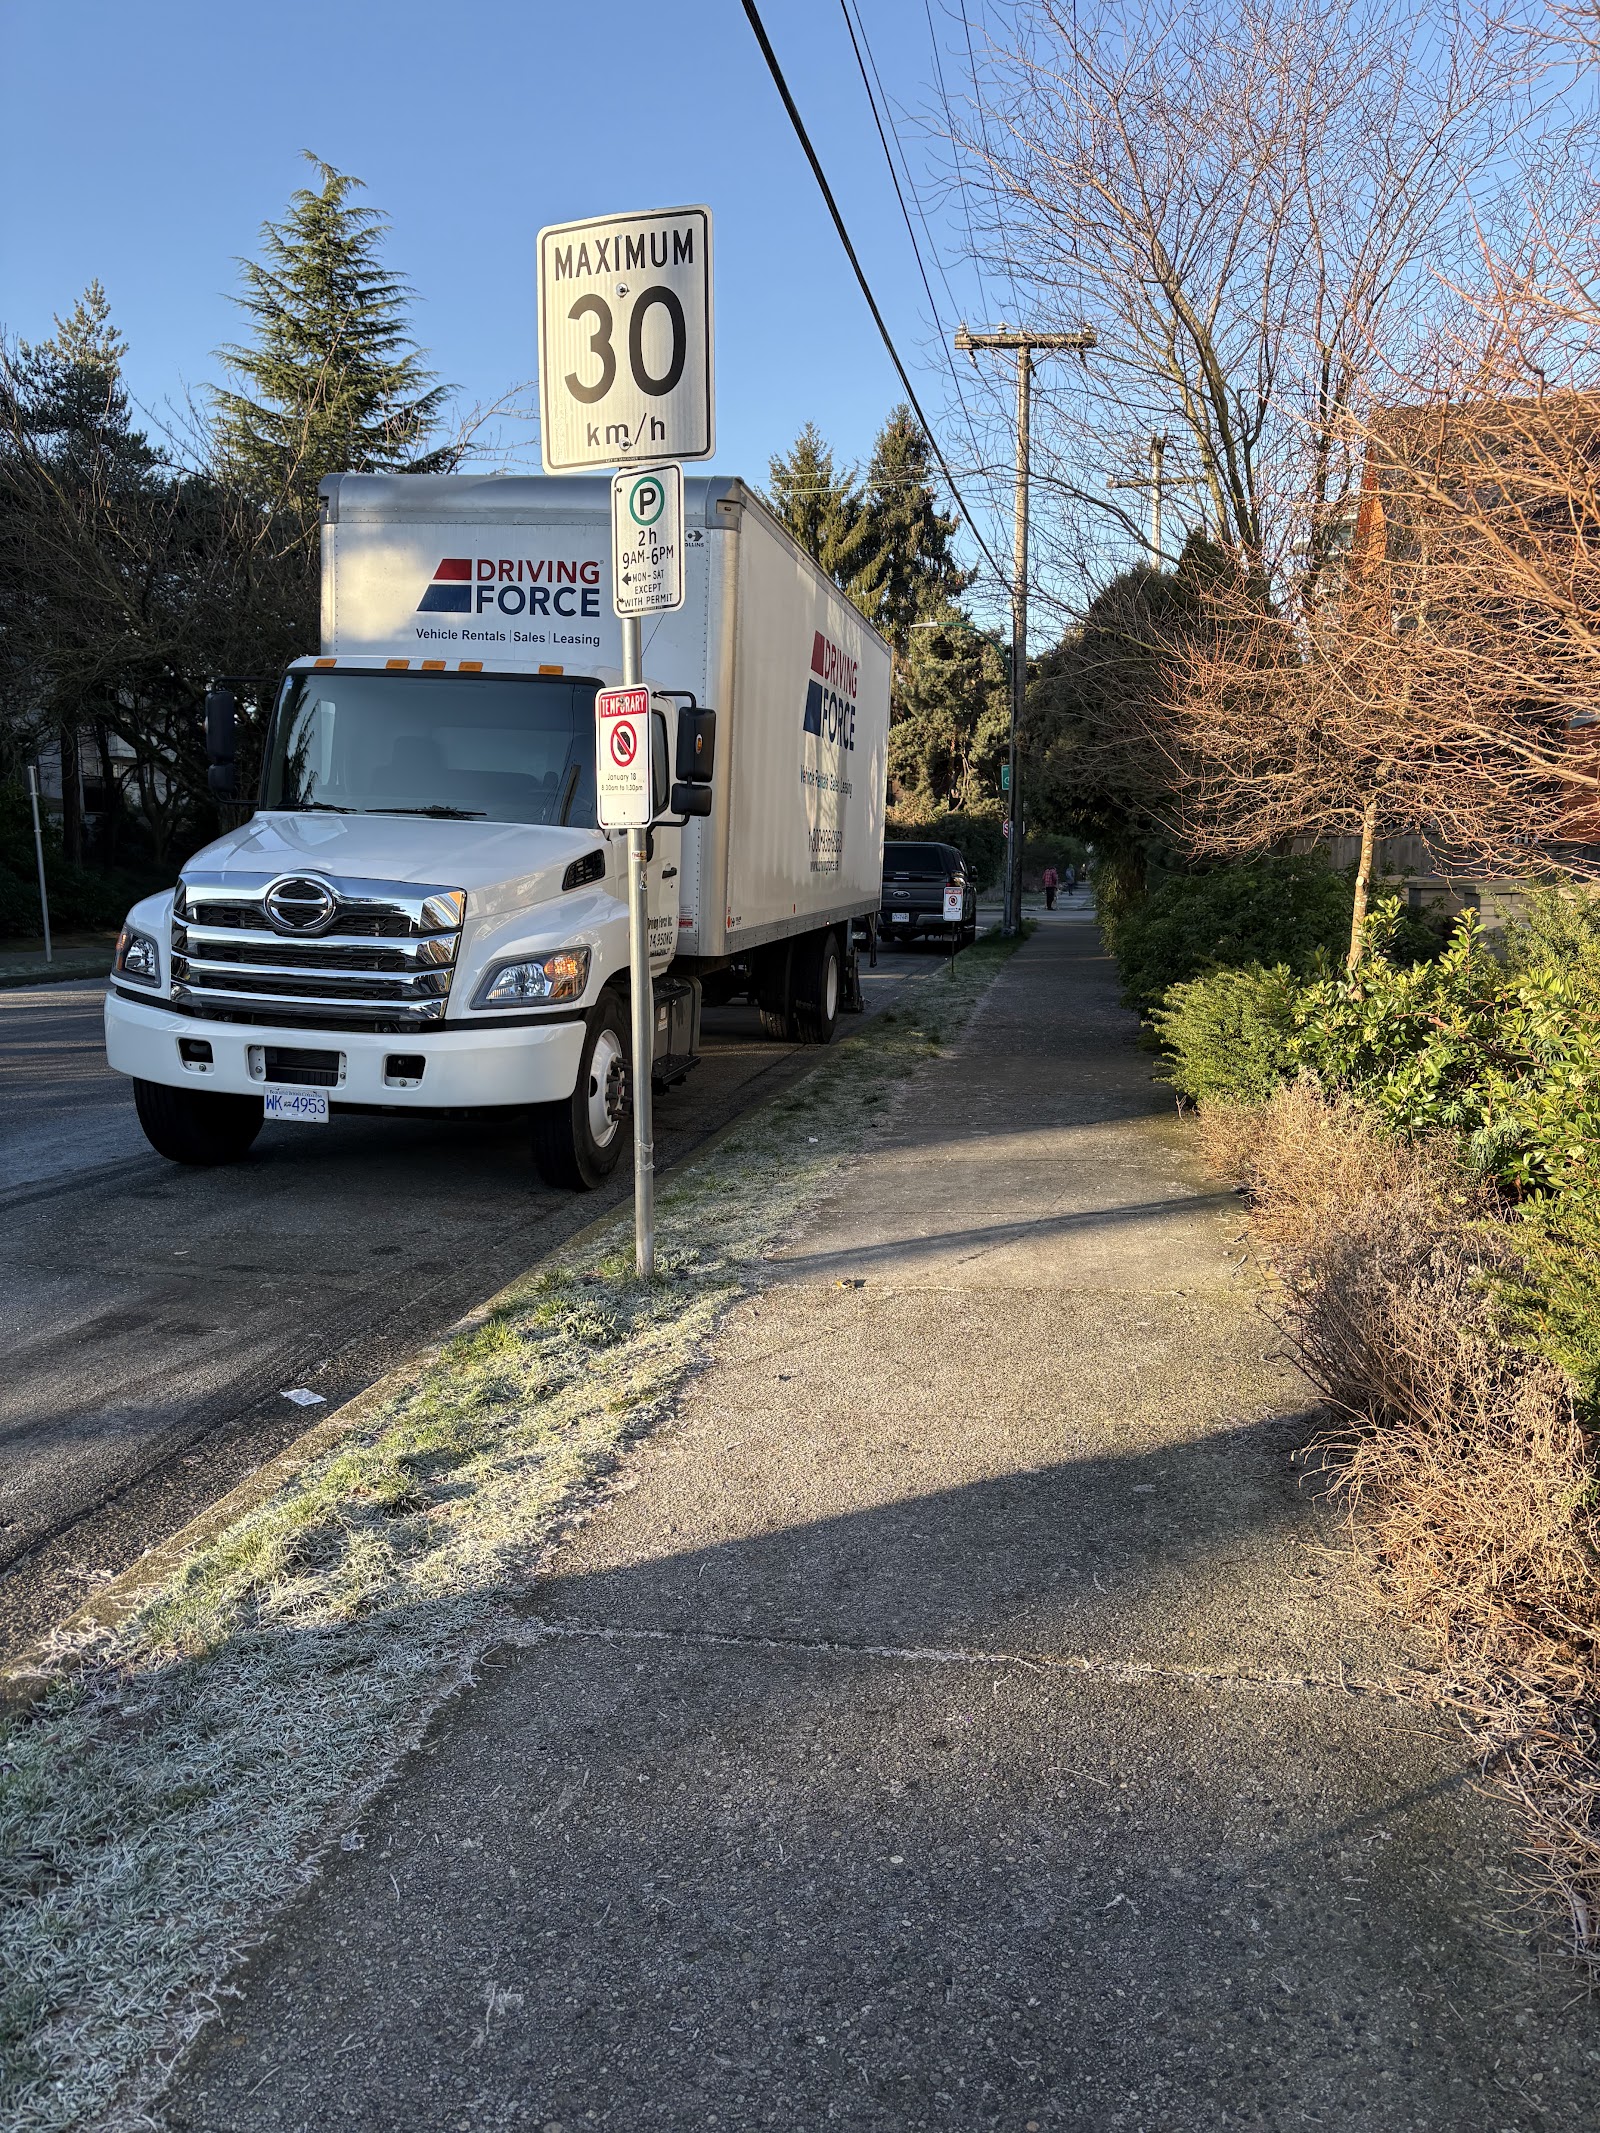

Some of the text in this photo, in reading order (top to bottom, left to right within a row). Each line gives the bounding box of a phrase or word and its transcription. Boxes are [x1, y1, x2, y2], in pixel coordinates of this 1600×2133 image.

[554, 228, 694, 281] MAXIMUM
[564, 285, 687, 404] 30
[586, 412, 666, 447] km/h
[639, 487, 656, 516] P
[622, 545, 674, 570] 9AM-6PM
[477, 559, 600, 585] DRIVING
[476, 585, 600, 617] FORCE
[624, 592, 673, 608] WITH PERMIT
[634, 582, 662, 595] EXCEPT
[416, 628, 600, 647] Vehicle Rentals Sales Leasing
[824, 639, 858, 699] DRIVING
[821, 687, 856, 751] FORCE
[608, 772, 637, 783] January 18
[291, 1096, 326, 1114] 4953
